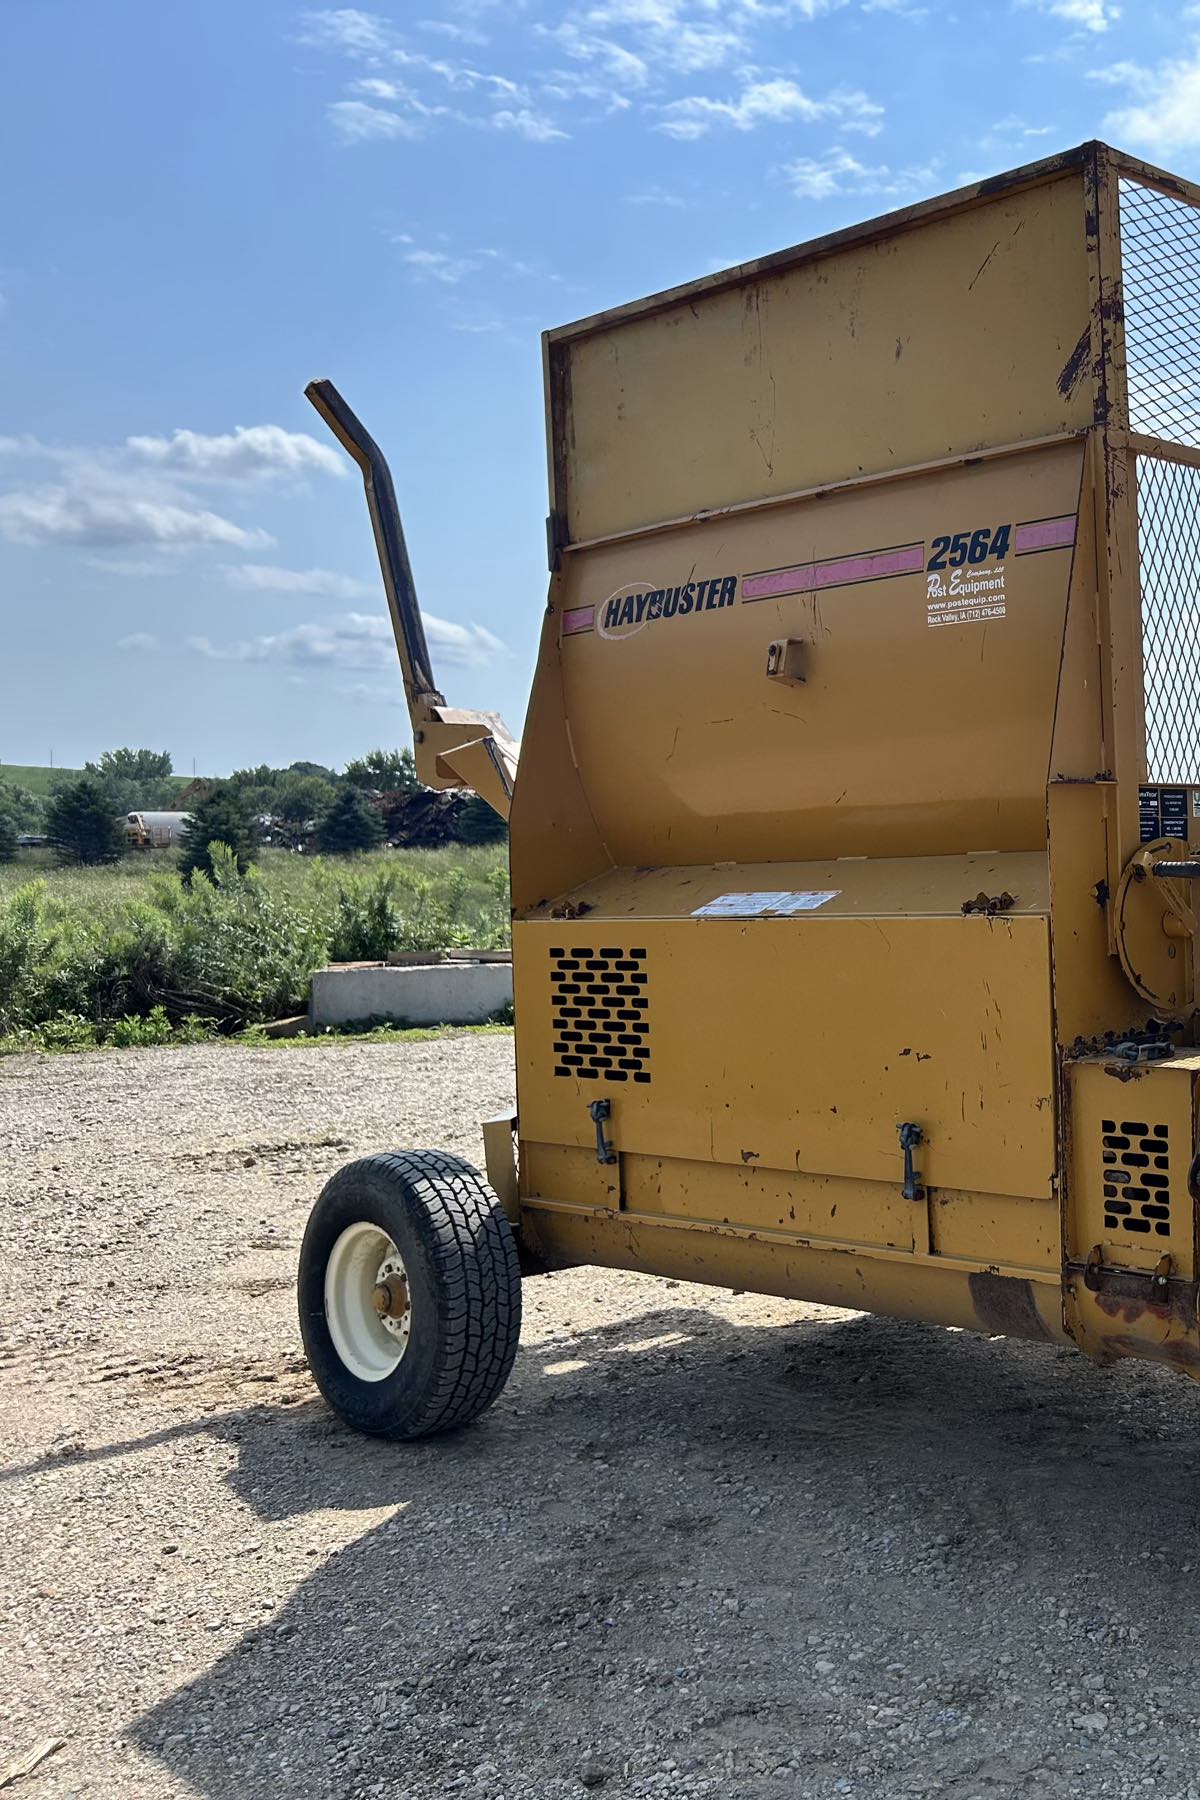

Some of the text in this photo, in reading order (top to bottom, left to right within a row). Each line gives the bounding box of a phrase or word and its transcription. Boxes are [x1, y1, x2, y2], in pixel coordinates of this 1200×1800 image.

[927, 524, 1011, 572] 2564
[927, 568, 1005, 599] Post Equipment
[604, 576, 737, 628] HAYBUSTER
[928, 594, 1005, 610] www.postequip.com
[928, 614, 941, 624] Rock
[967, 609, 981, 620] (712)
